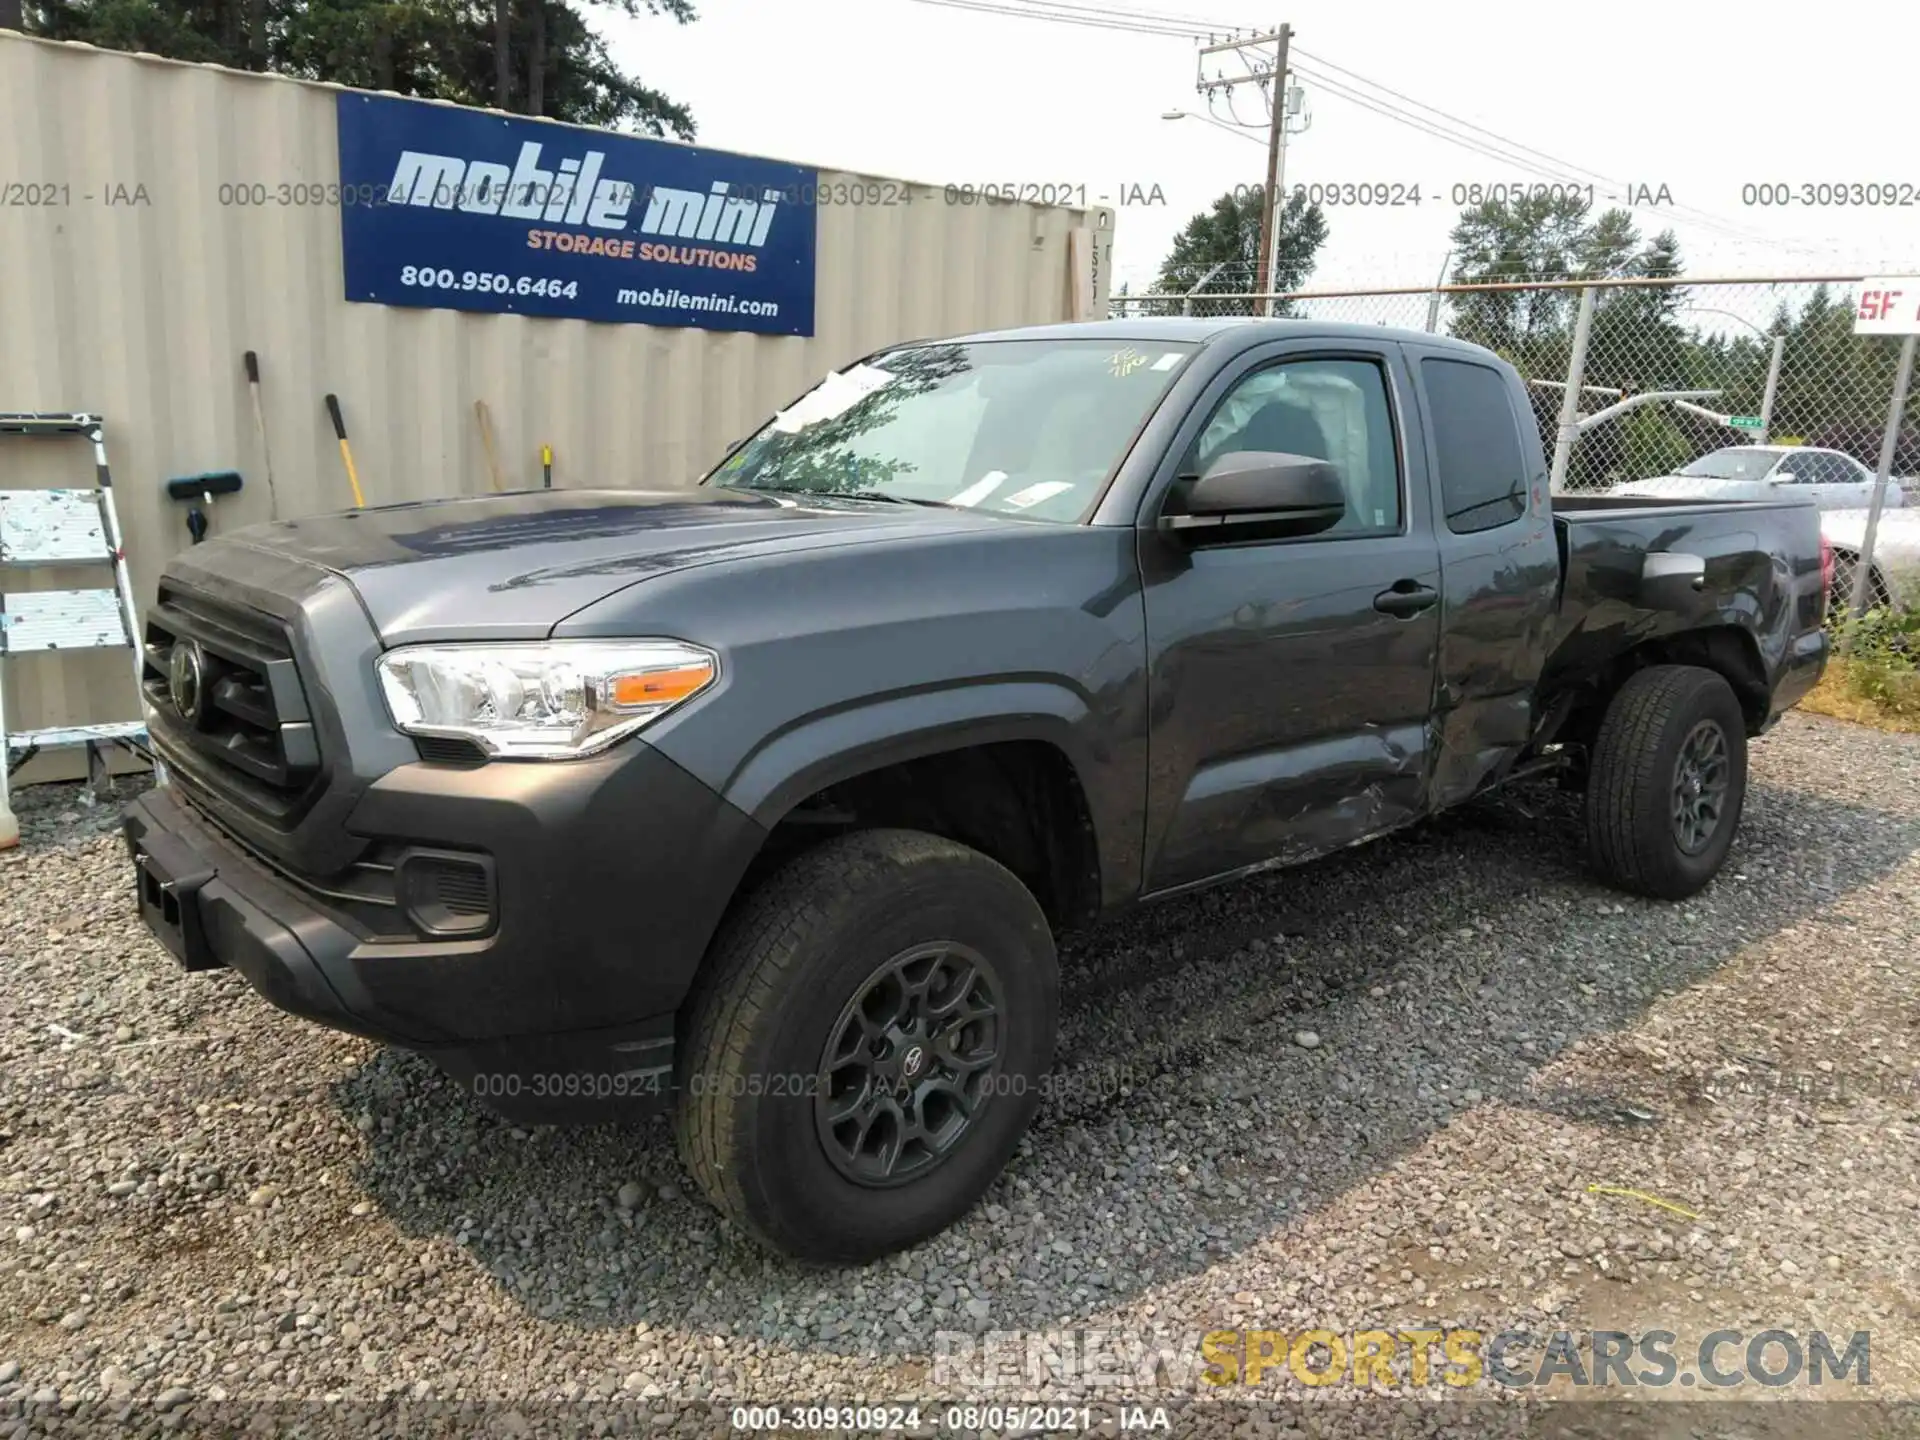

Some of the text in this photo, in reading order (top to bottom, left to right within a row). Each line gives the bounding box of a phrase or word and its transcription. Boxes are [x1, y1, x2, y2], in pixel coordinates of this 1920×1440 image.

[387, 141, 781, 247] mobile mini
[526, 229, 757, 273] STORAGE SOLUTIONS
[401, 266, 578, 299] 800.950.6464
[617, 286, 778, 317] mobilemini.com
[1858, 290, 1903, 320] SF
